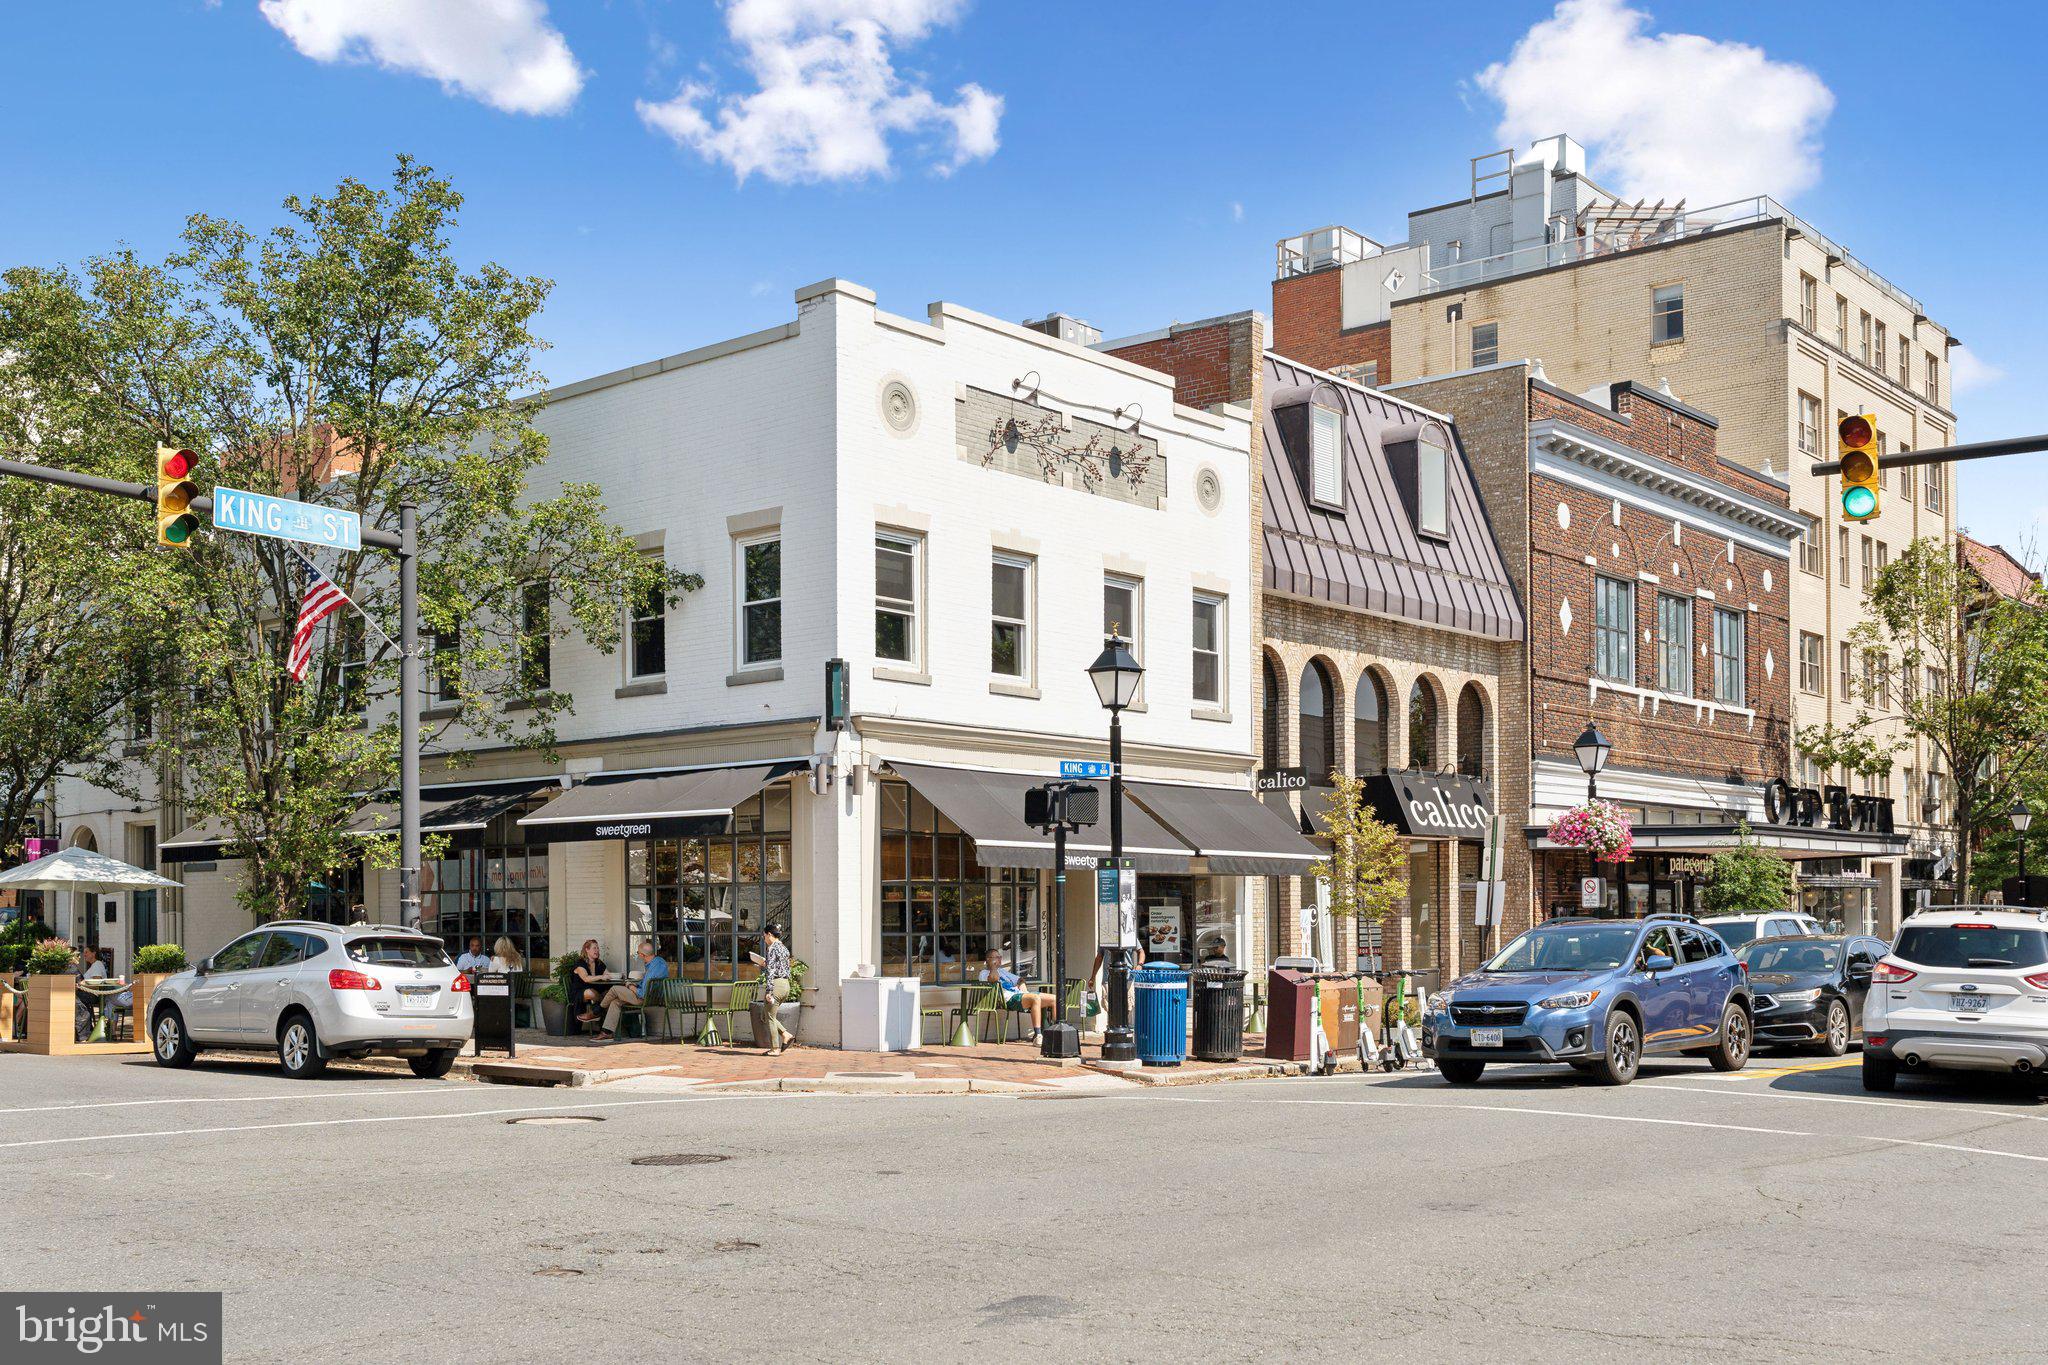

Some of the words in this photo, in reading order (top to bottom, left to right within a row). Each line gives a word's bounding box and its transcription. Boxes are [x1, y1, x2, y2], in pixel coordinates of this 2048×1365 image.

[221, 494, 282, 532] KING
[323, 513, 353, 544] ST
[1064, 762, 1083, 773] KING
[1258, 771, 1306, 789] calico
[1409, 786, 1489, 829] calico
[595, 823, 651, 838] sweetgreen
